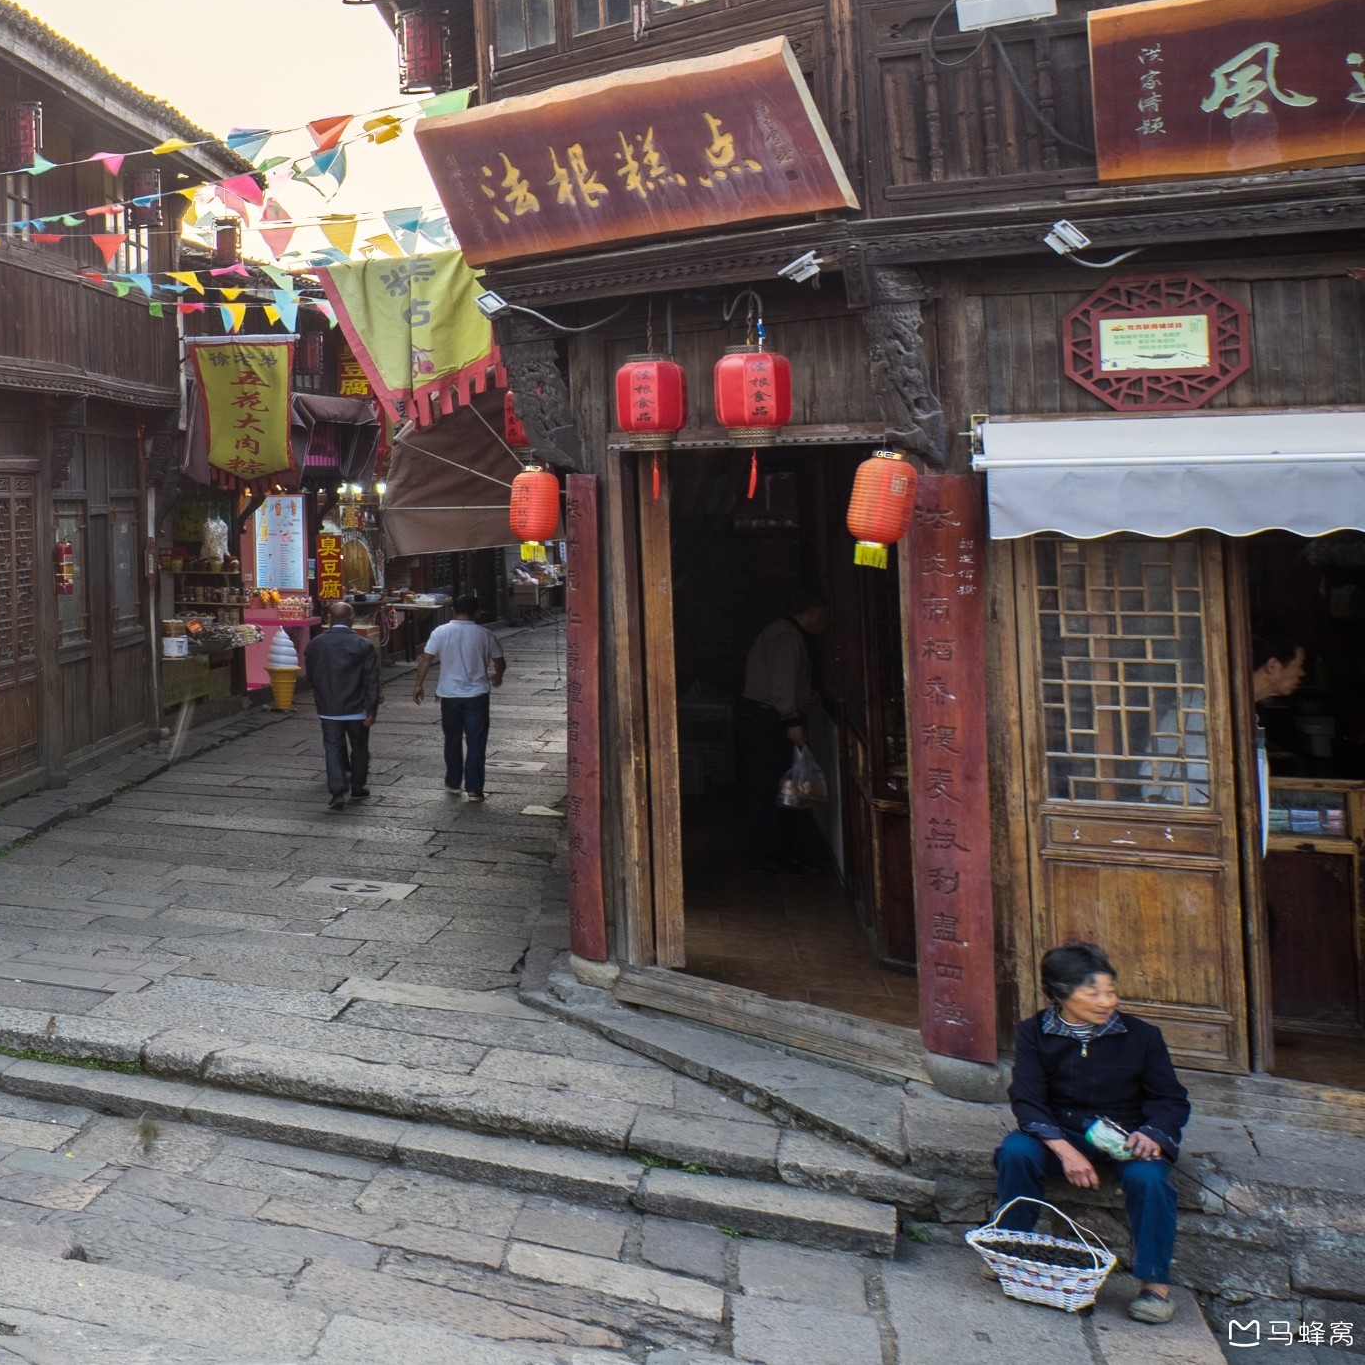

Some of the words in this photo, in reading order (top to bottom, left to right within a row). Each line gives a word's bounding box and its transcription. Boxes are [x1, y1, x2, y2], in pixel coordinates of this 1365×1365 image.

[480, 111, 763, 225] 法根糕点
[224, 369, 272, 476] 五花大肉粽
[317, 537, 342, 599] 臭豆腐
